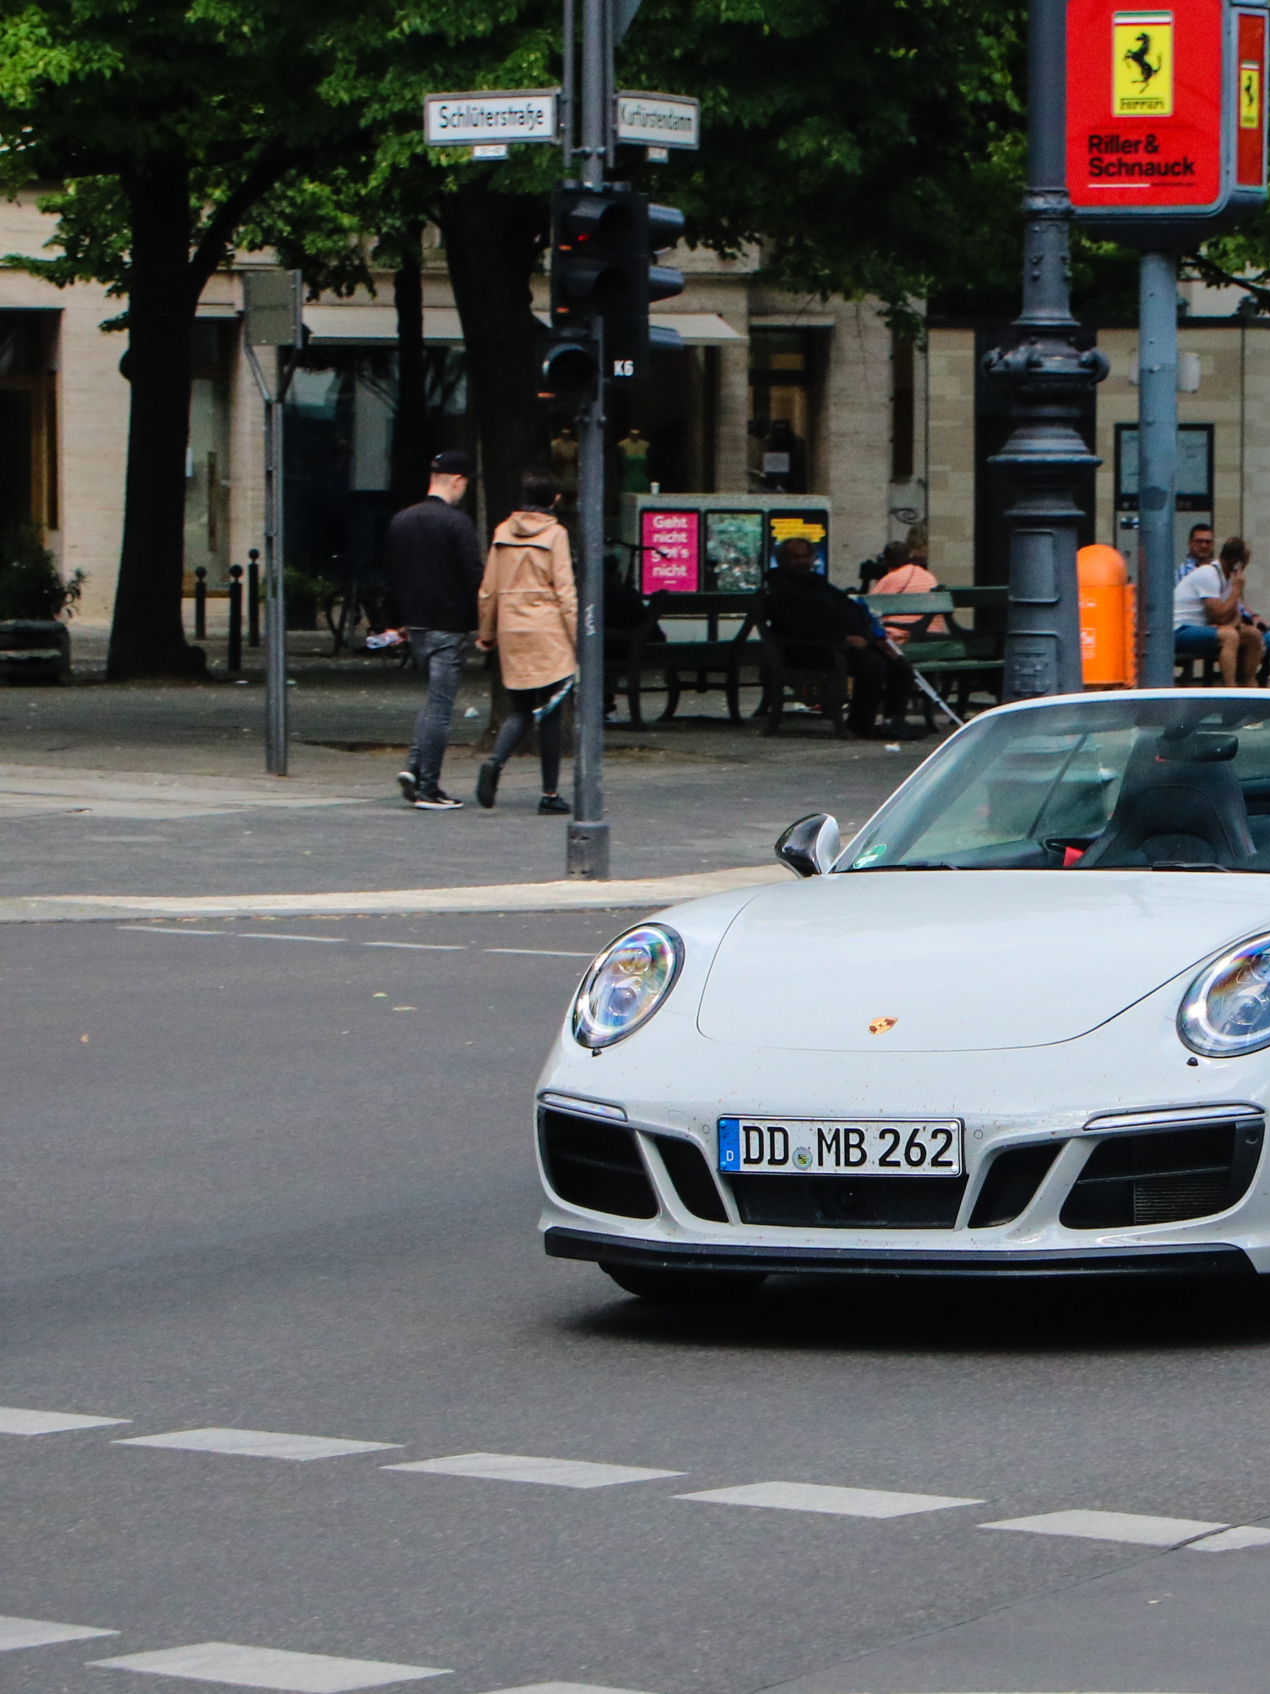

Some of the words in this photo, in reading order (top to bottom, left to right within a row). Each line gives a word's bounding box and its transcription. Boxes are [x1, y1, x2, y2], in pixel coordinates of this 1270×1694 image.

[438, 103, 545, 131] Schlüterstraße
[619, 102, 692, 132] Kurfürstendamm
[1088, 134, 1141, 153] Riller
[1144, 133, 1160, 153] &
[1088, 156, 1194, 177] Schnauck
[613, 359, 634, 377] K6
[653, 515, 688, 529] Geht
[653, 531, 688, 544] nicht
[653, 564, 688, 577] nicht
[725, 1150, 735, 1161] D
[742, 1125, 790, 1166] DD
[817, 1127, 868, 1168] MB
[878, 1127, 954, 1168] 262
